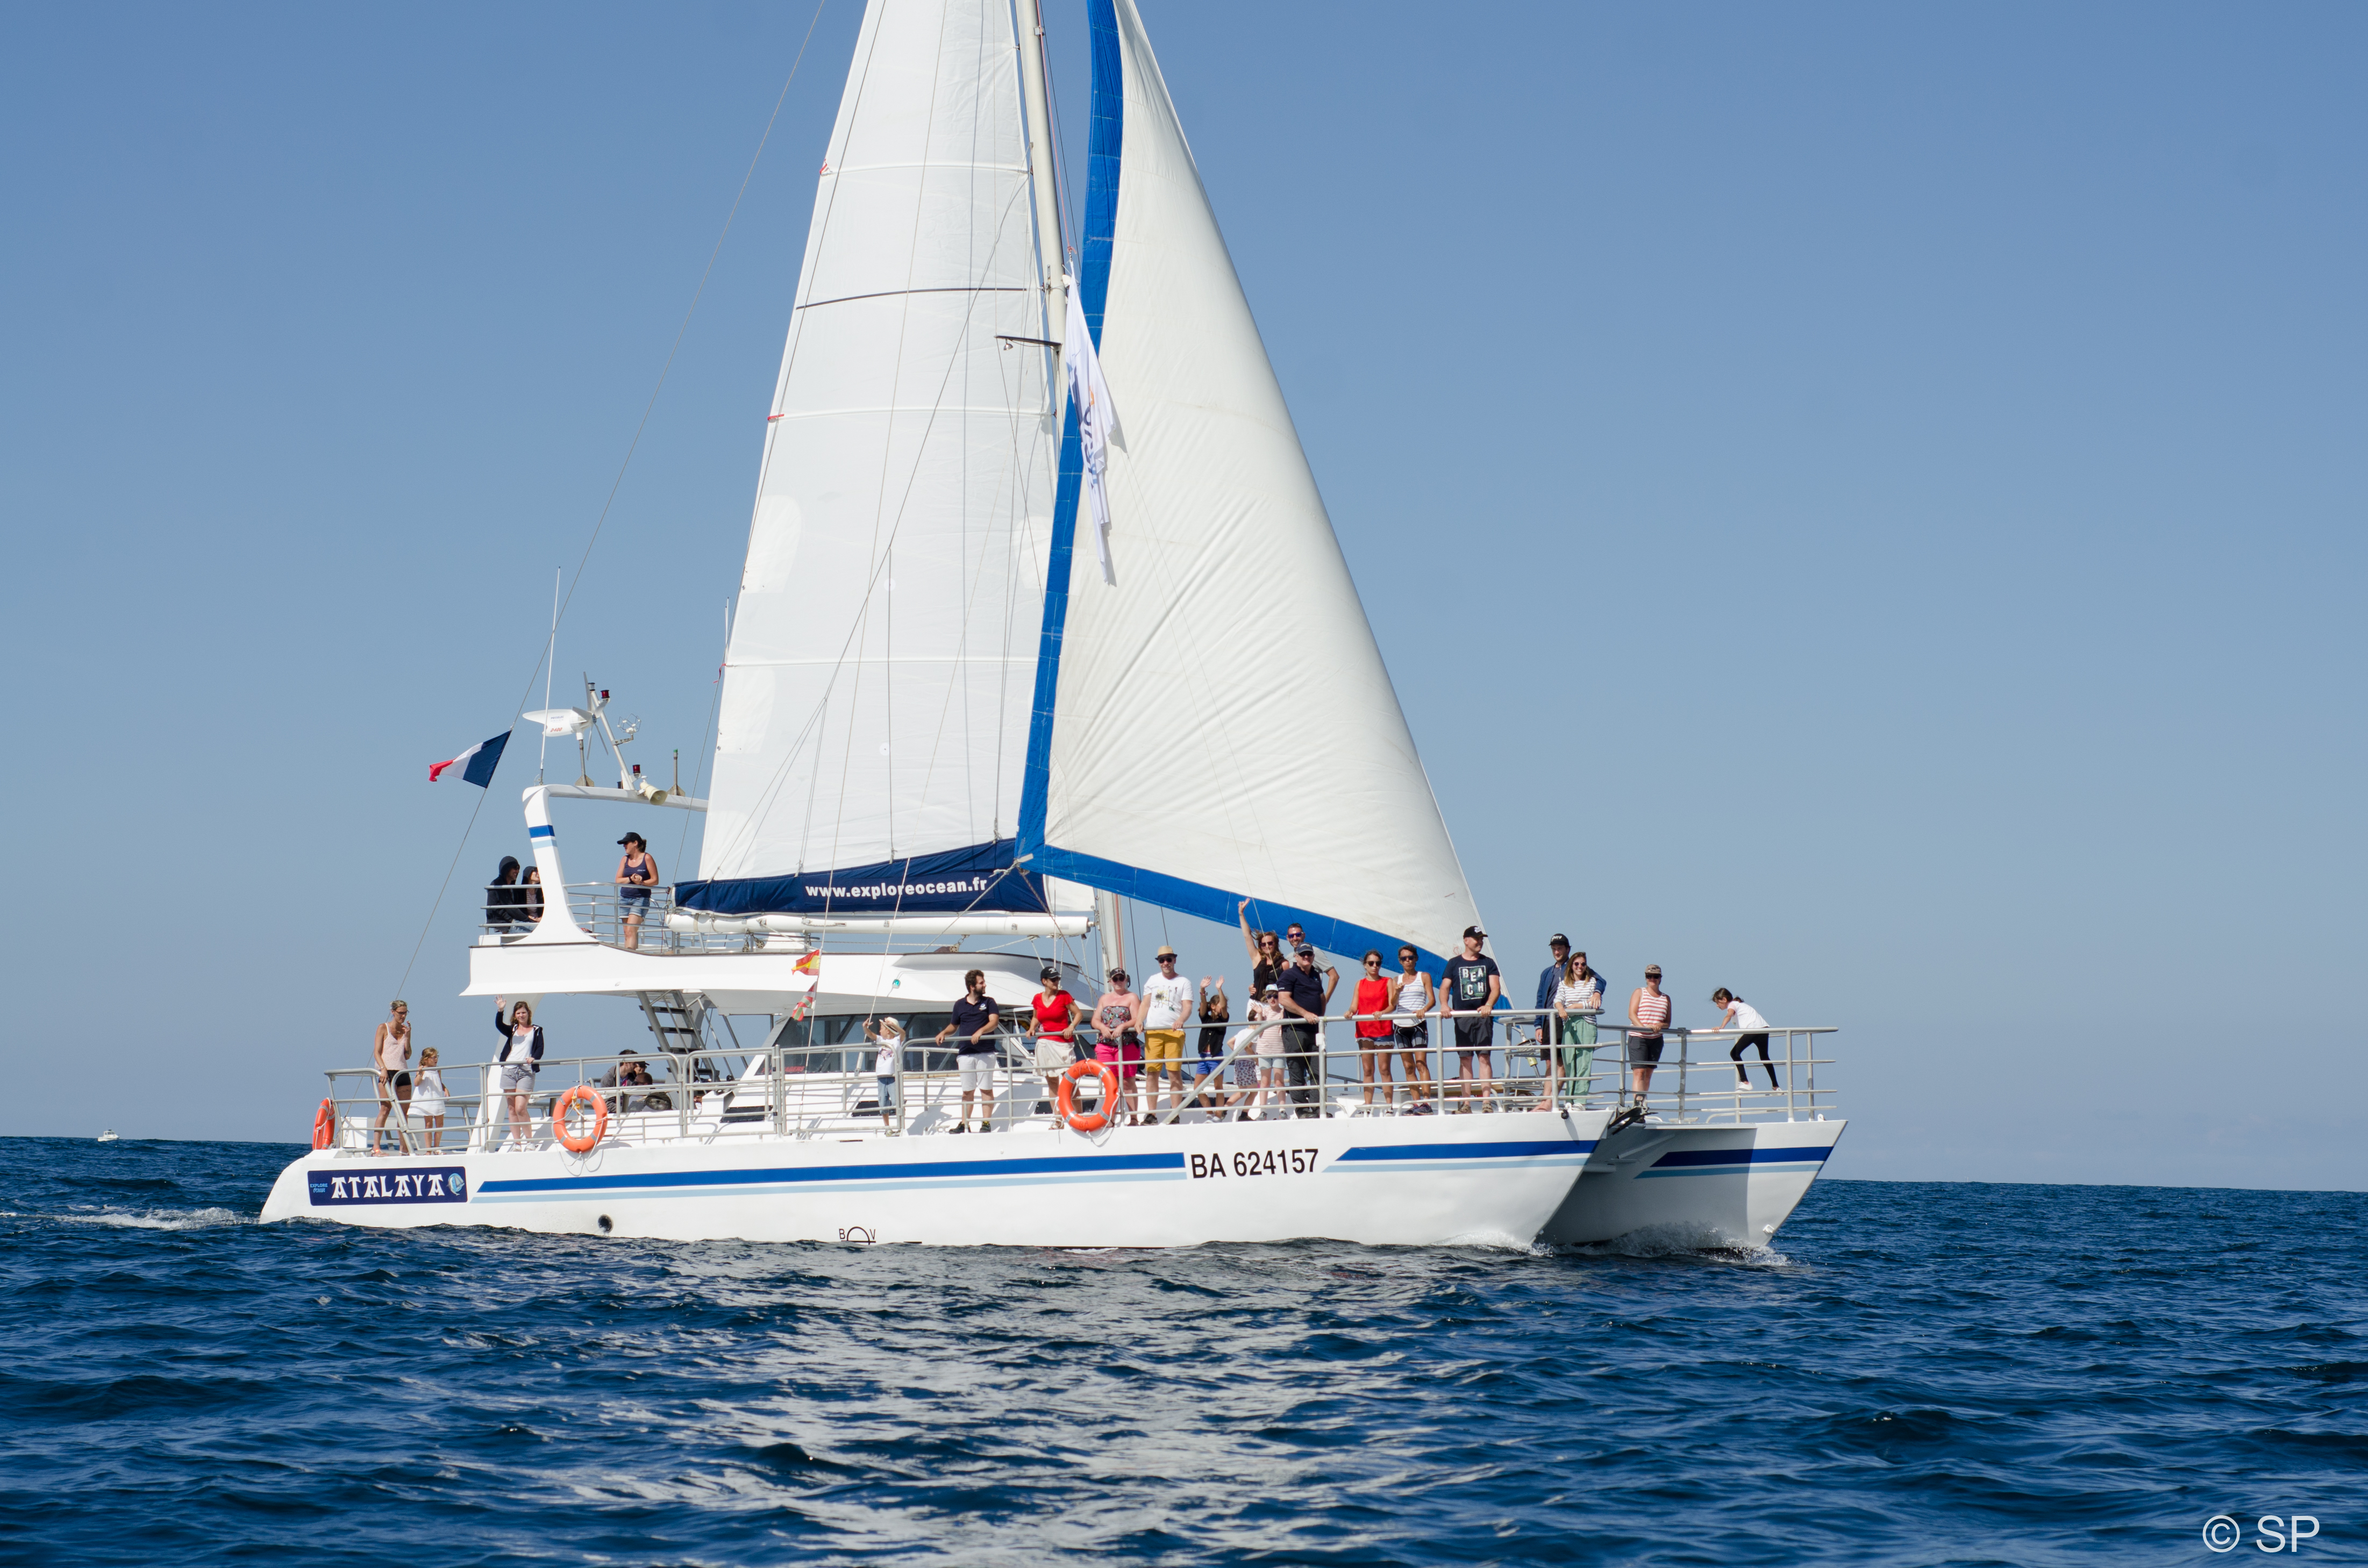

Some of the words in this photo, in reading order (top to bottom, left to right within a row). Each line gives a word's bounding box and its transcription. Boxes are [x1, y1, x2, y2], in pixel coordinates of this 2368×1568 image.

[805, 877, 987, 899] www.exploreocean.fr
[1190, 1153, 1227, 1178] BA
[1233, 1148, 1318, 1177] 624157
[331, 1174, 445, 1199] ATALAYA
